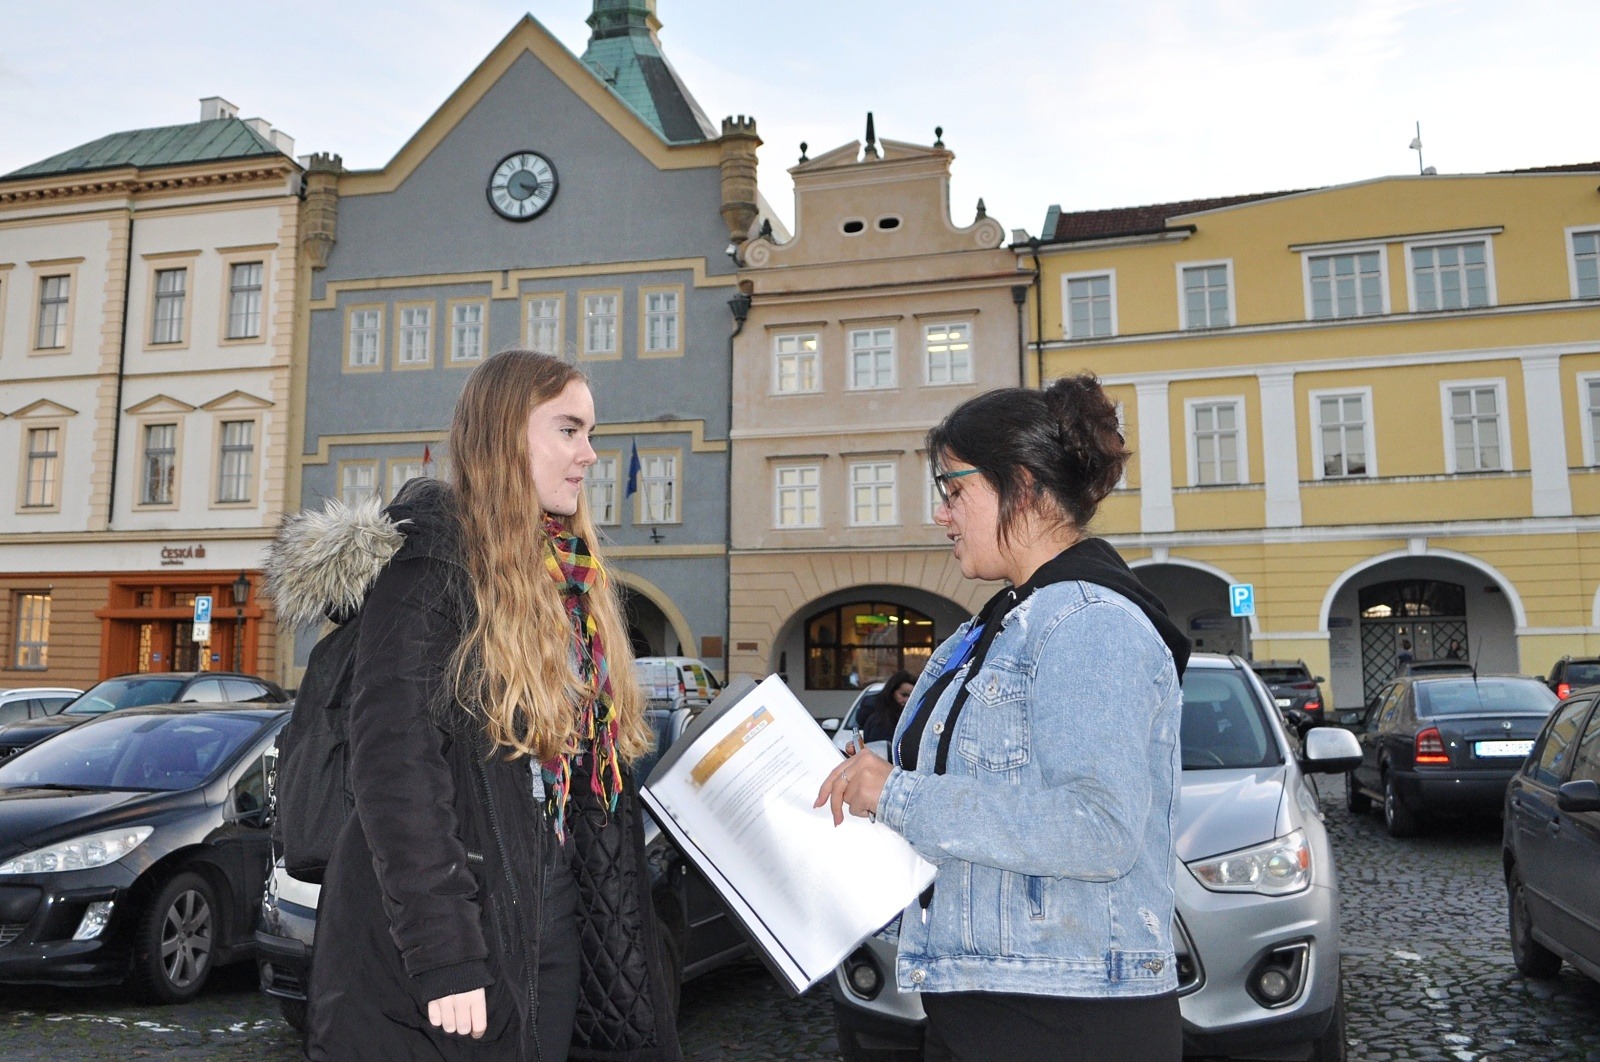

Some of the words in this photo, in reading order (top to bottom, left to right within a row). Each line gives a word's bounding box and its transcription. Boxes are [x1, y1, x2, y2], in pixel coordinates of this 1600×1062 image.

[161, 545, 193, 558] ČESKÁ
[1235, 587, 1249, 607] P
[197, 599, 208, 615] P
